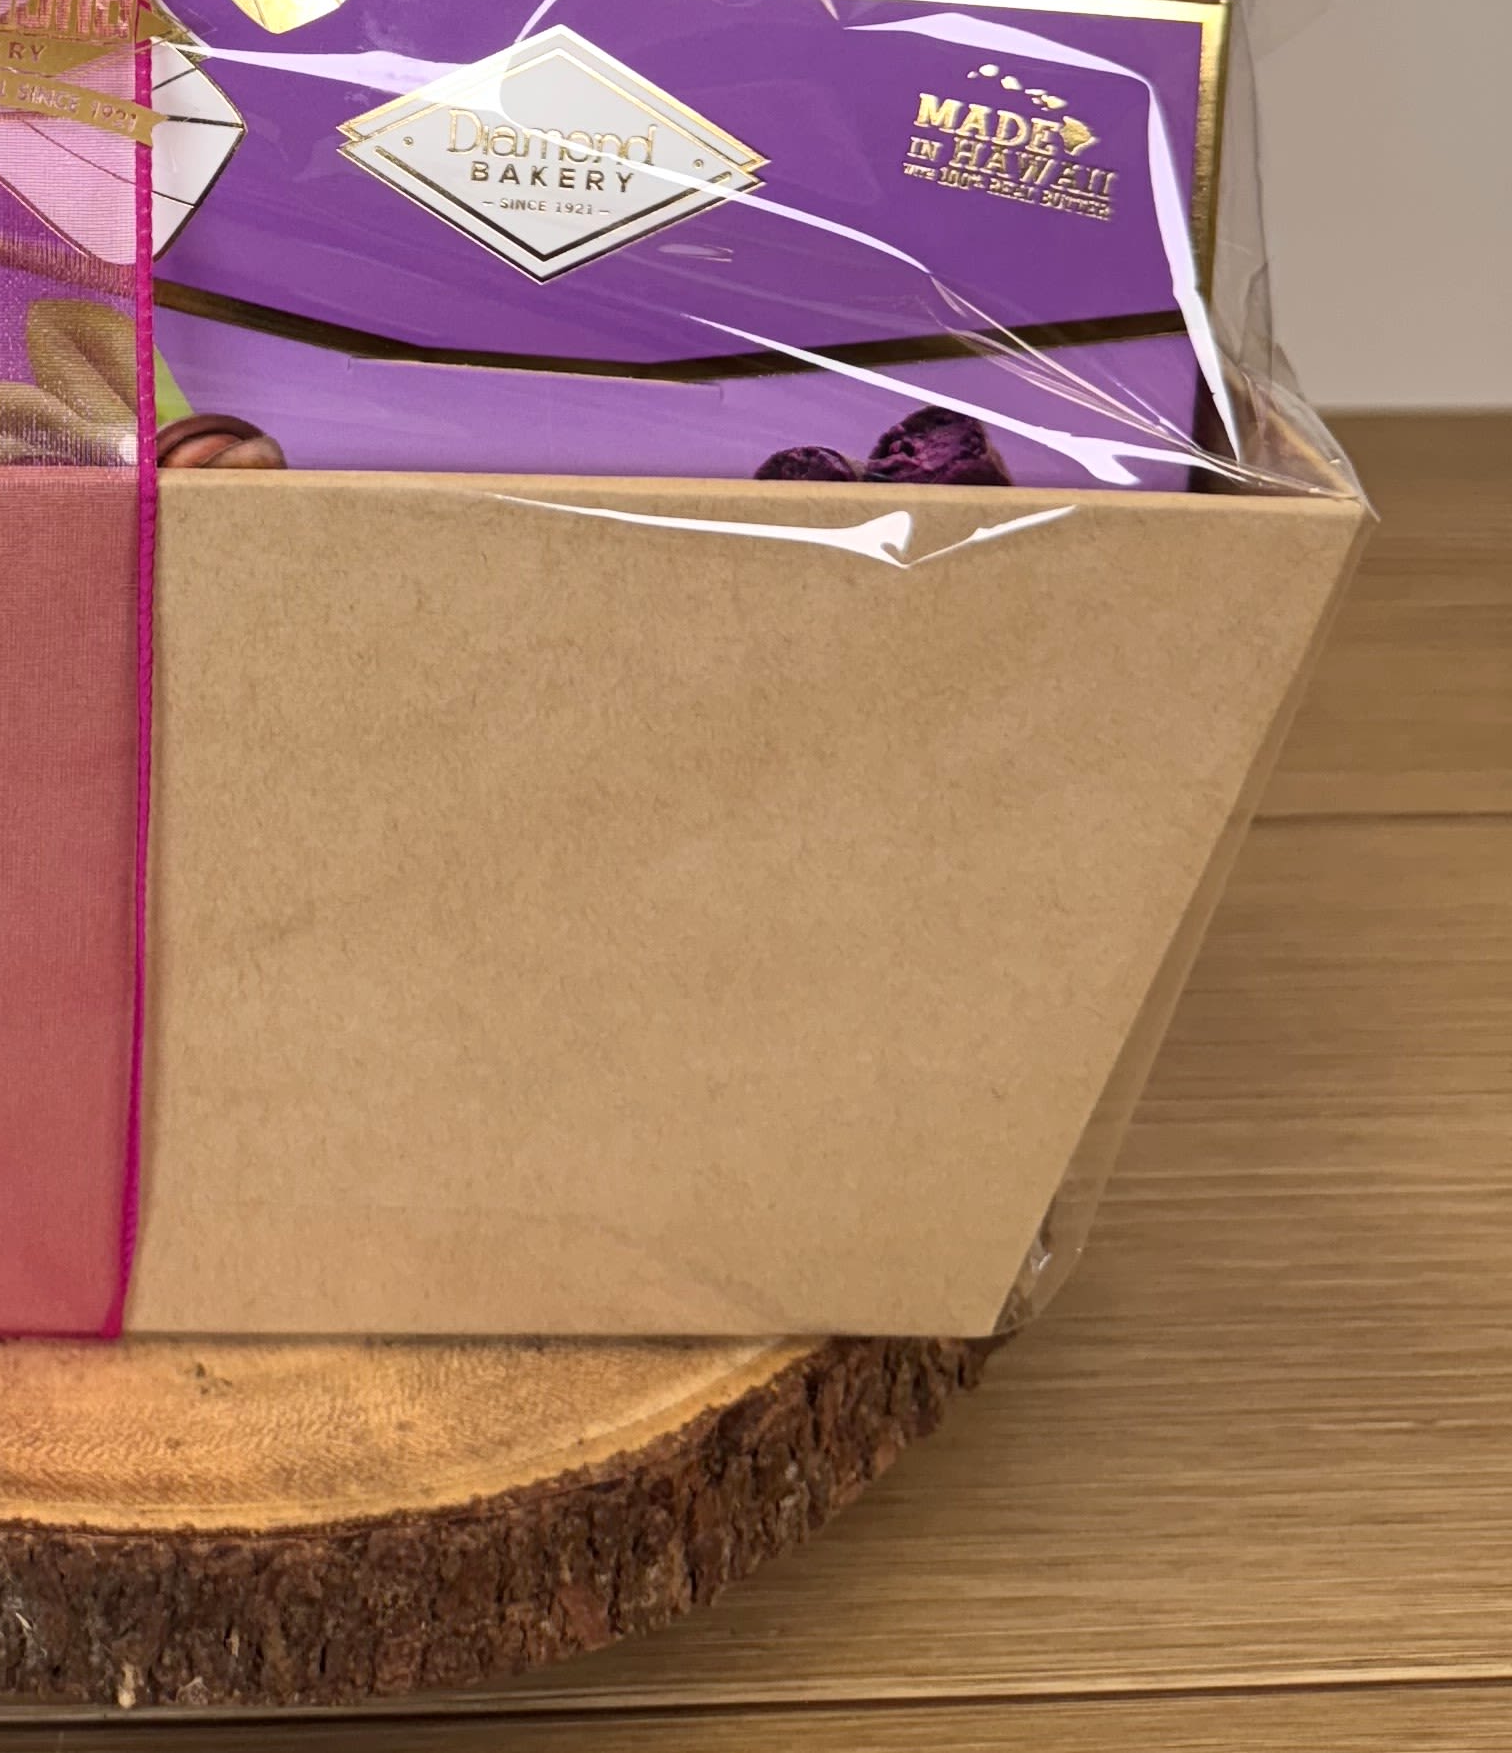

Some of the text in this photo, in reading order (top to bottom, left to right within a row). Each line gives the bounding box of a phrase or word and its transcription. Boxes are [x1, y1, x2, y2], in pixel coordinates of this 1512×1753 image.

[17, 86, 80, 115] SINCE
[90, 100, 138, 133] 1921
[913, 93, 1063, 156] MADE
[446, 108, 658, 167] Diamond
[470, 160, 635, 193] BAKERY
[906, 136, 1119, 201] IN HAWAII
[499, 197, 594, 215] SINCE 1921
[1039, 189, 1113, 222] BUTTER
